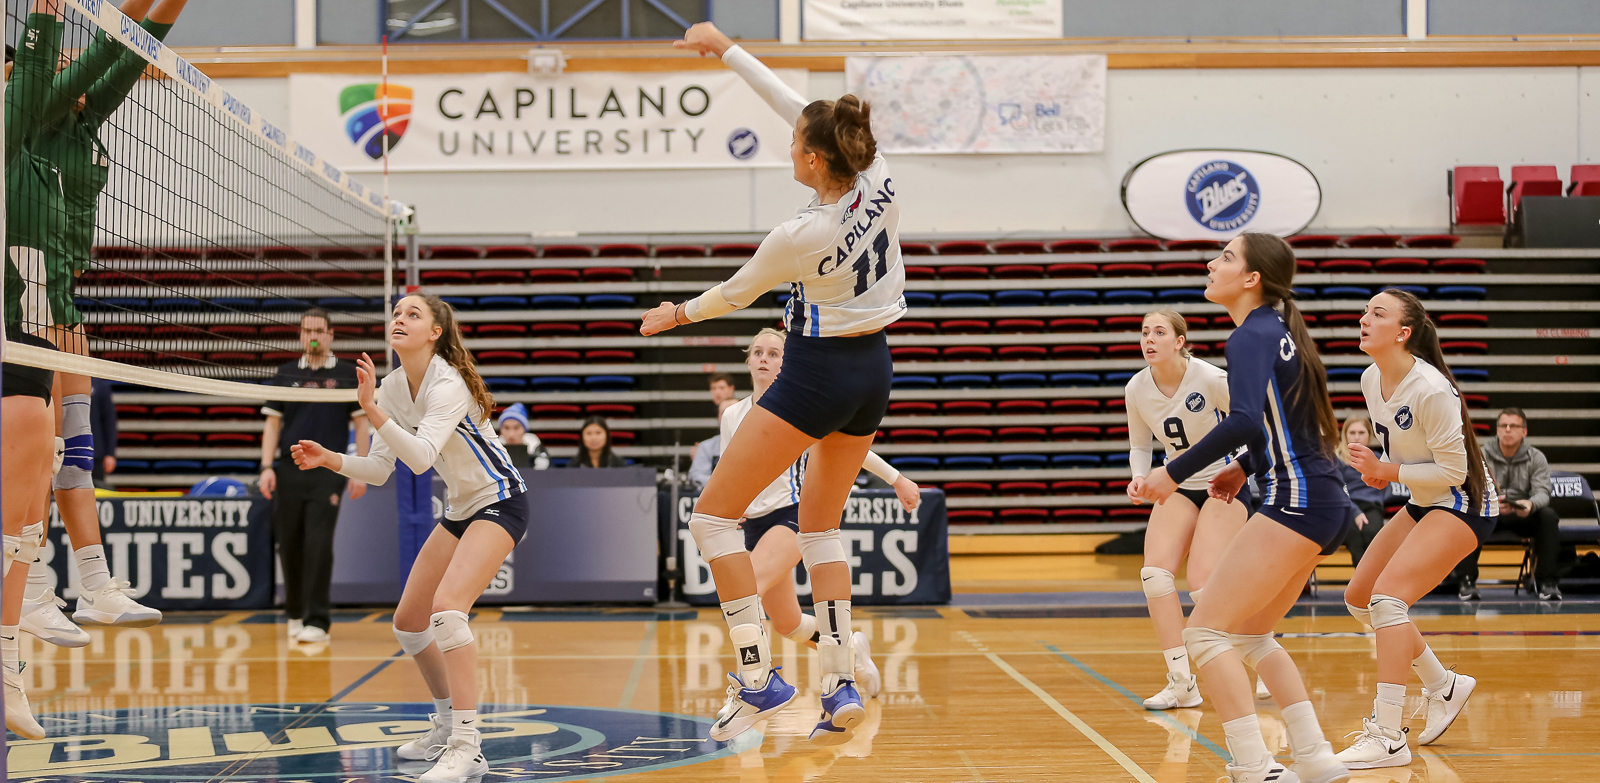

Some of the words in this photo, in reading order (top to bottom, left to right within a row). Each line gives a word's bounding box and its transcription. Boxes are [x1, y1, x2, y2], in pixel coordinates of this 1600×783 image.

[438, 86, 709, 119] CAPILANO
[438, 128, 705, 155] UNIVERSITY
[1187, 162, 1230, 193] CAPILANO
[1195, 171, 1248, 223] Blues
[1209, 192, 1259, 230] UNIVERSITY
[852, 227, 890, 298] 11
[1163, 416, 1191, 451] 9
[123, 501, 252, 527] UNIVERSITY
[843, 497, 921, 524] ERSITY
